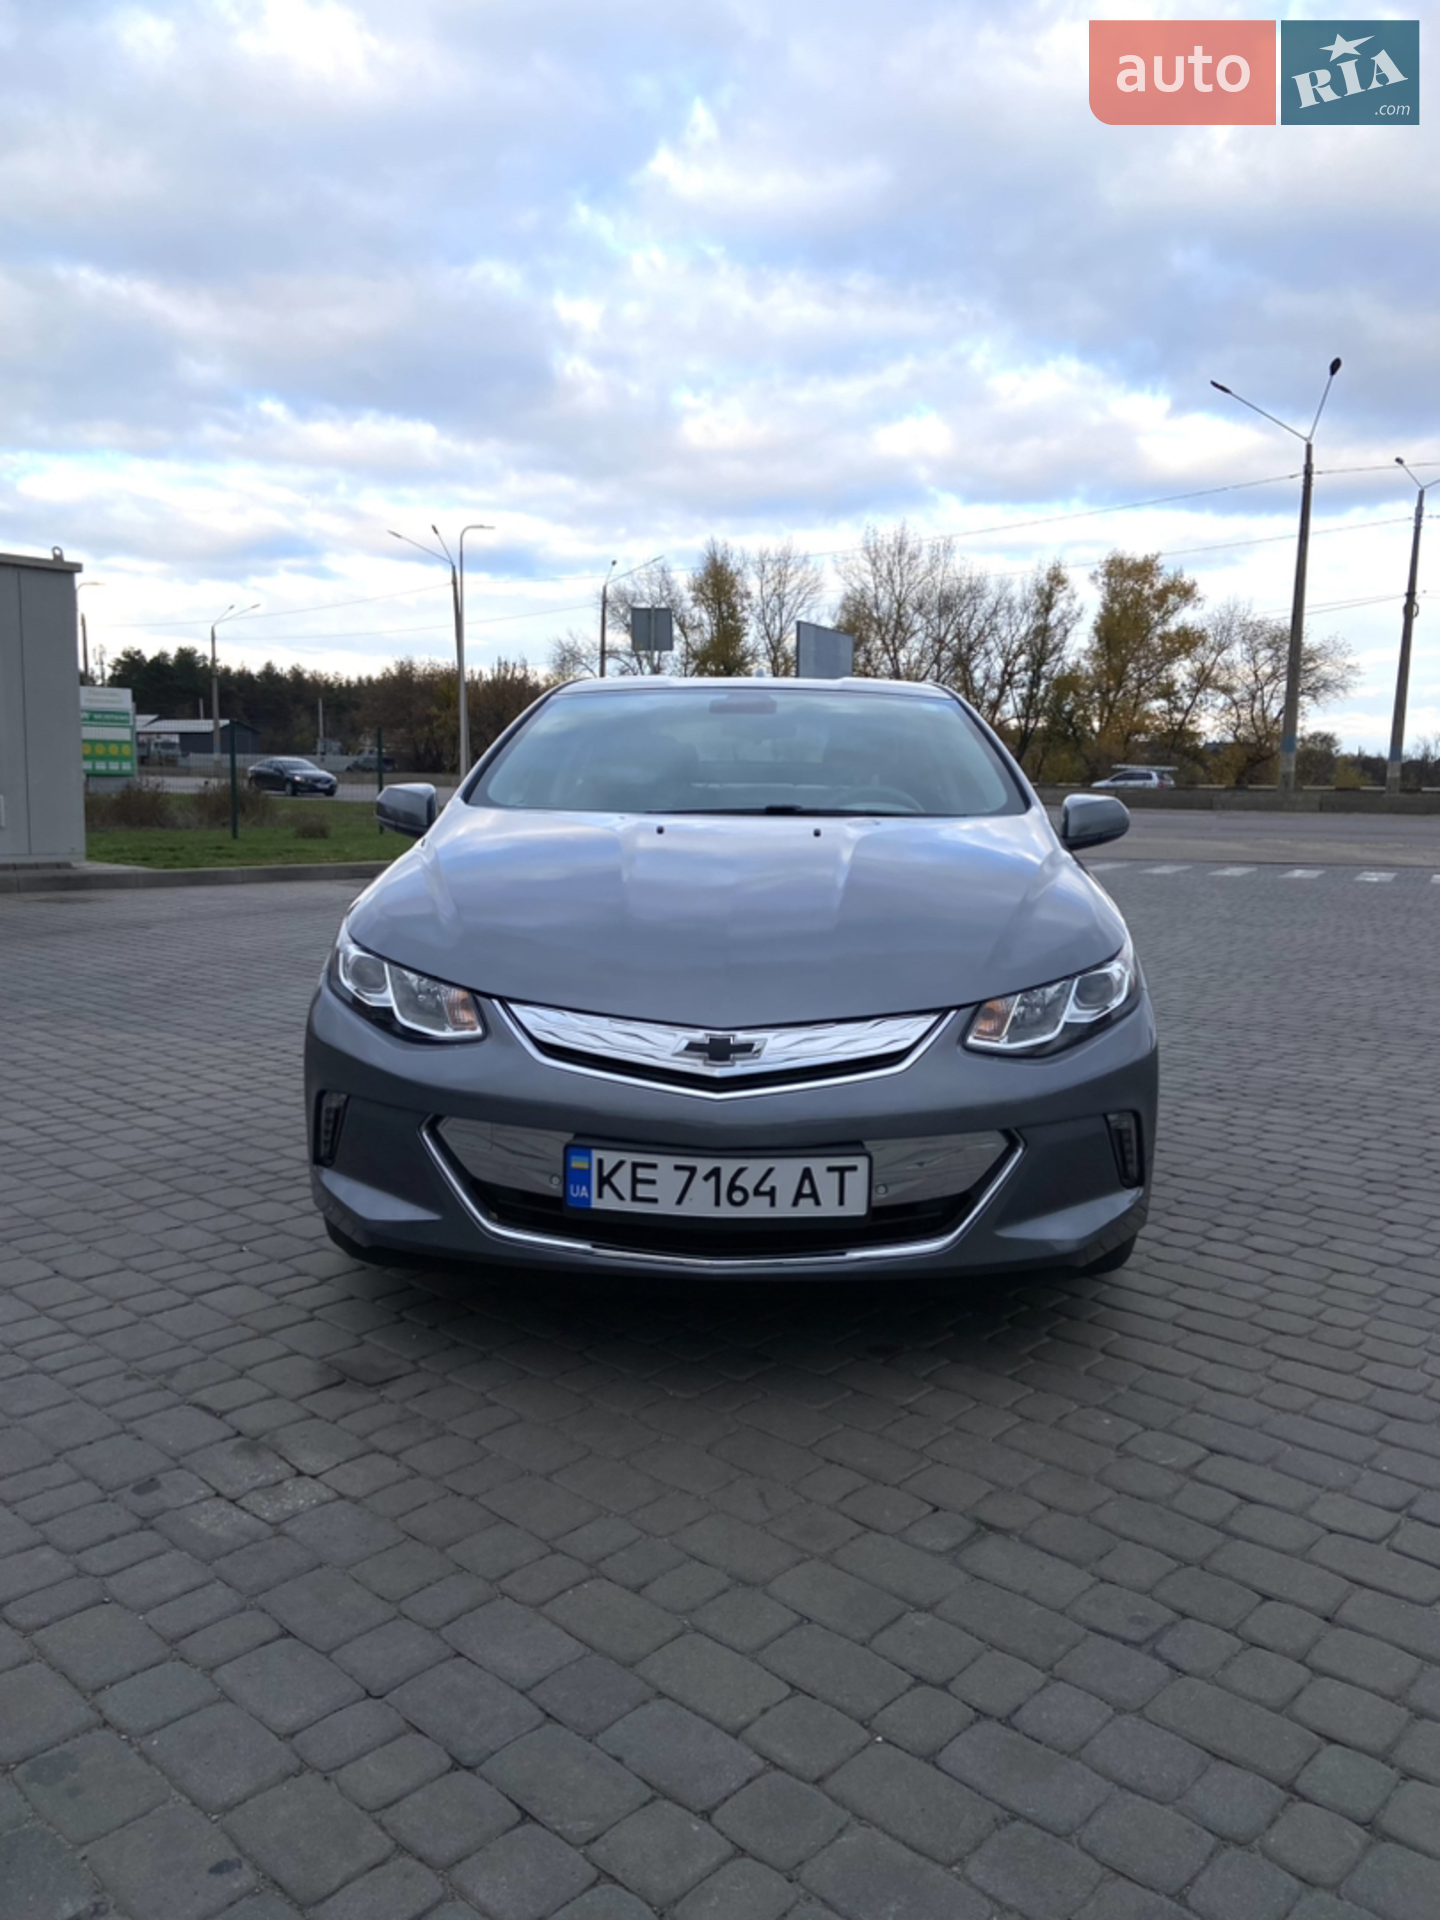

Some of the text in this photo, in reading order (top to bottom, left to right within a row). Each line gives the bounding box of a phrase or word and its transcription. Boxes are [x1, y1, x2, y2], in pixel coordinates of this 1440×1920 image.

[569, 1184, 589, 1198] UA
[596, 1157, 858, 1208] KE 7164 AT
